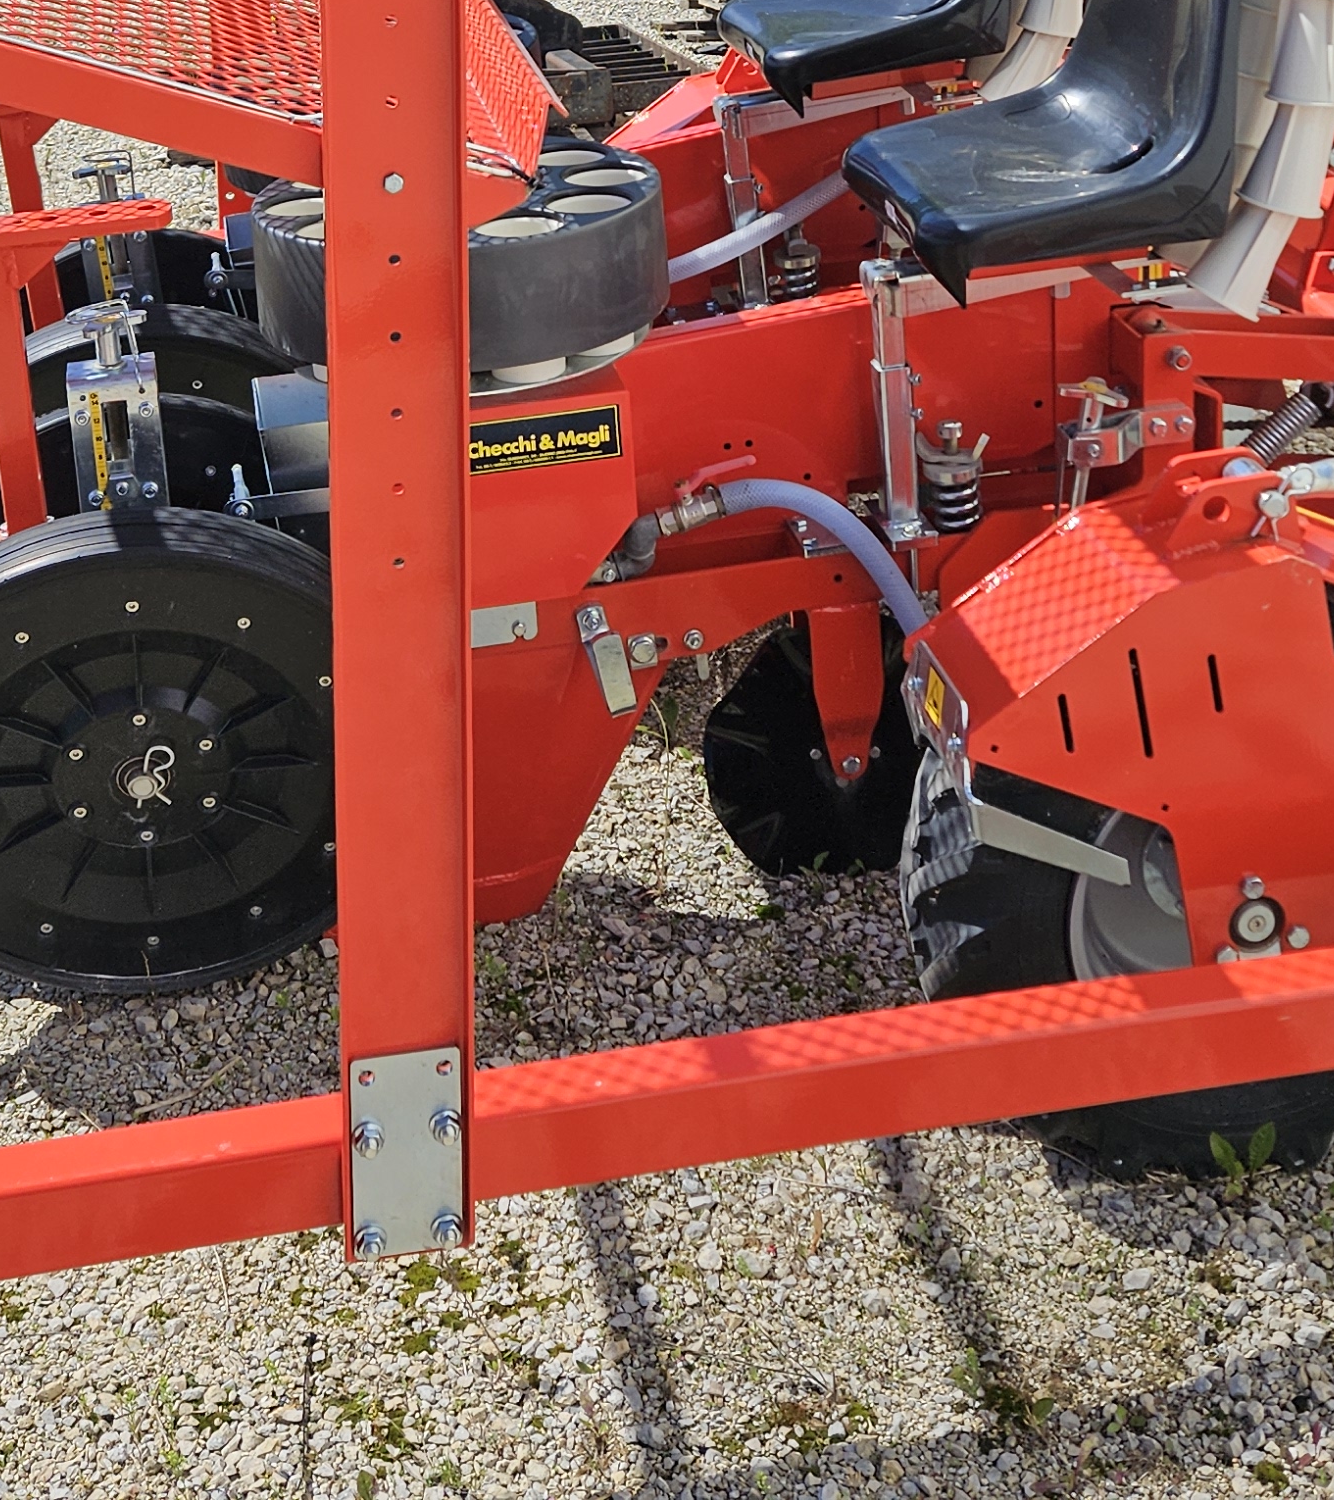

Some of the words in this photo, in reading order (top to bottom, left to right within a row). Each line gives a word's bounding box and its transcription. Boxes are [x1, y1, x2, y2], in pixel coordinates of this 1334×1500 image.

[469, 434, 537, 459] Checchi
[539, 434, 555, 450] &
[557, 424, 611, 448] Magli
